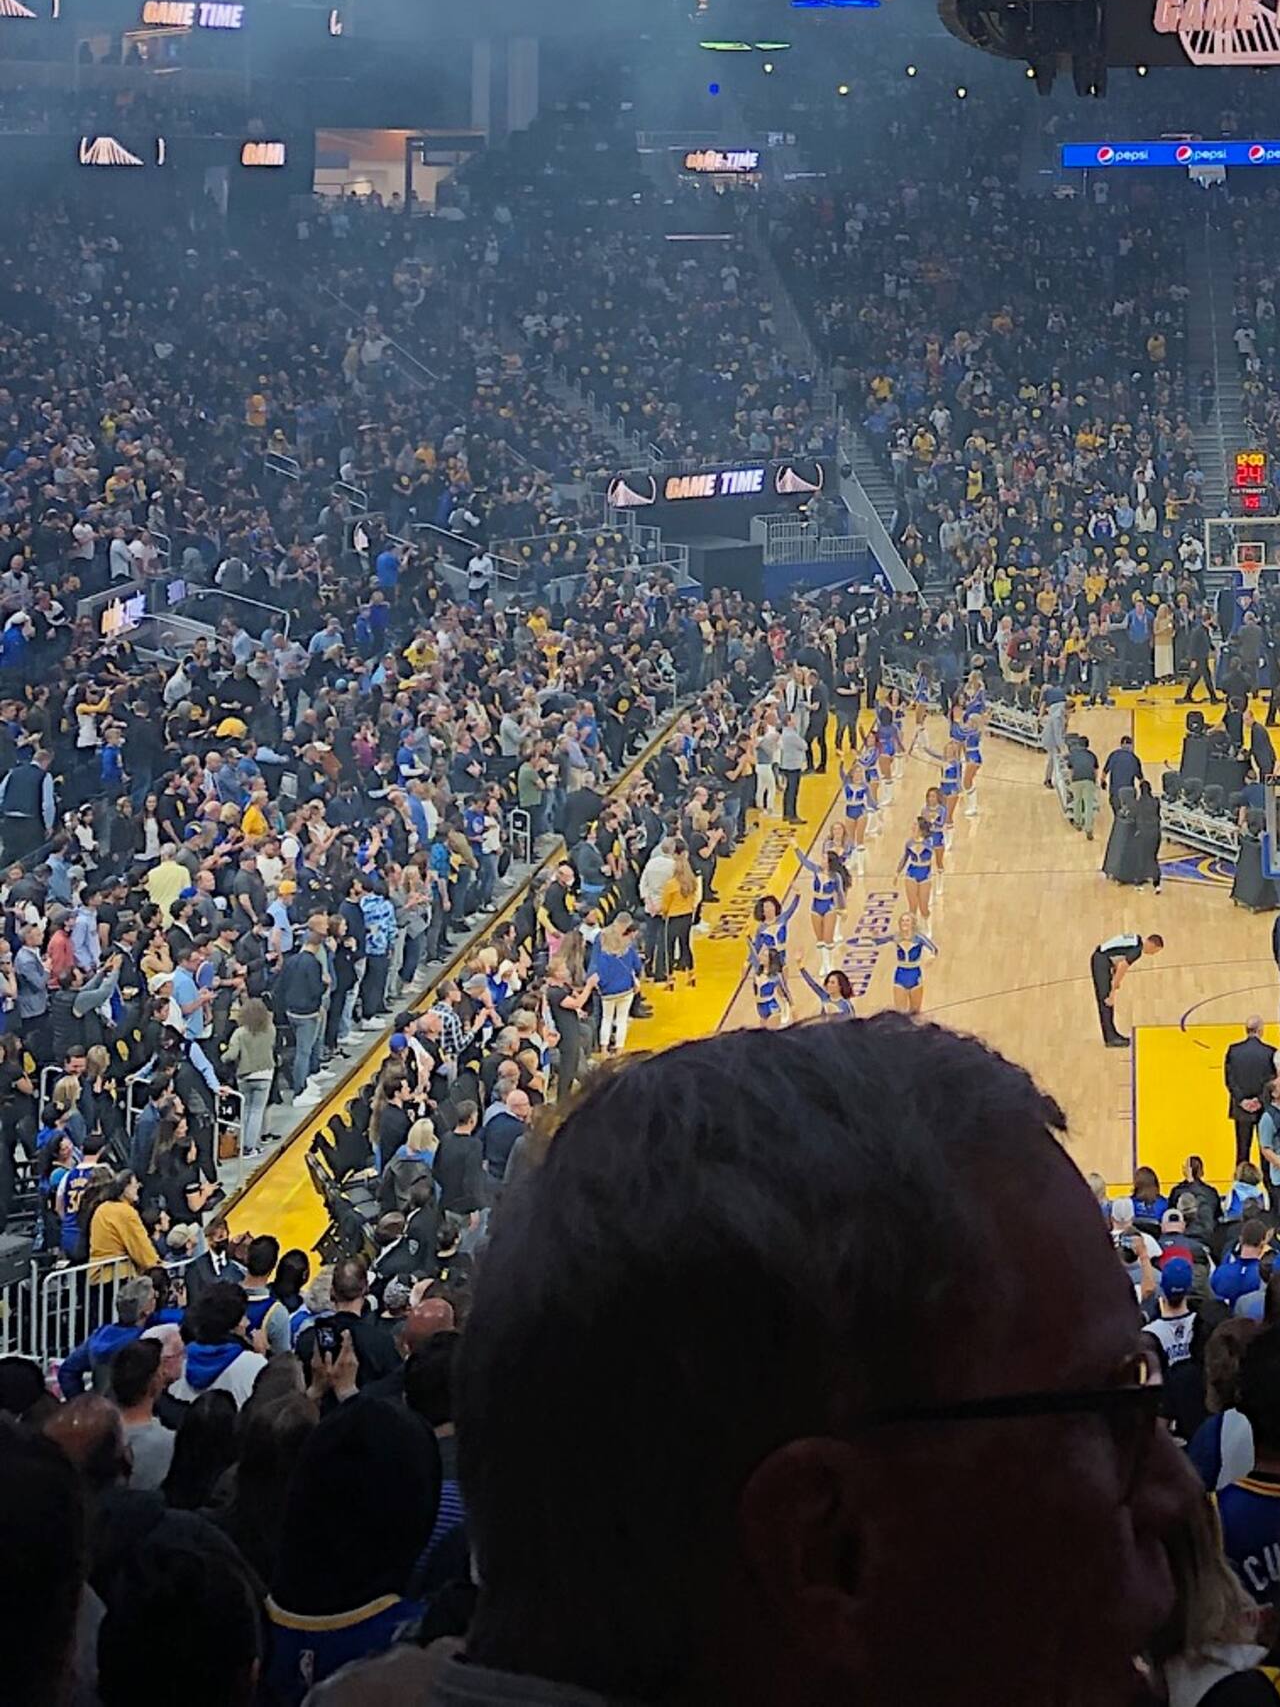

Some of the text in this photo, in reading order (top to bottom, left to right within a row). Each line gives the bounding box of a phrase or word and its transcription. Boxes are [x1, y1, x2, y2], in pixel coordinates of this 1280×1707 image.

[143, 0, 244, 29] GAME TIME
[1115, 150, 1148, 162] pepsi
[1195, 149, 1227, 161] pepsi
[665, 469, 764, 500] GAME TIME
[1236, 466, 1263, 485] 24
[221, 1105, 233, 1115] 14
